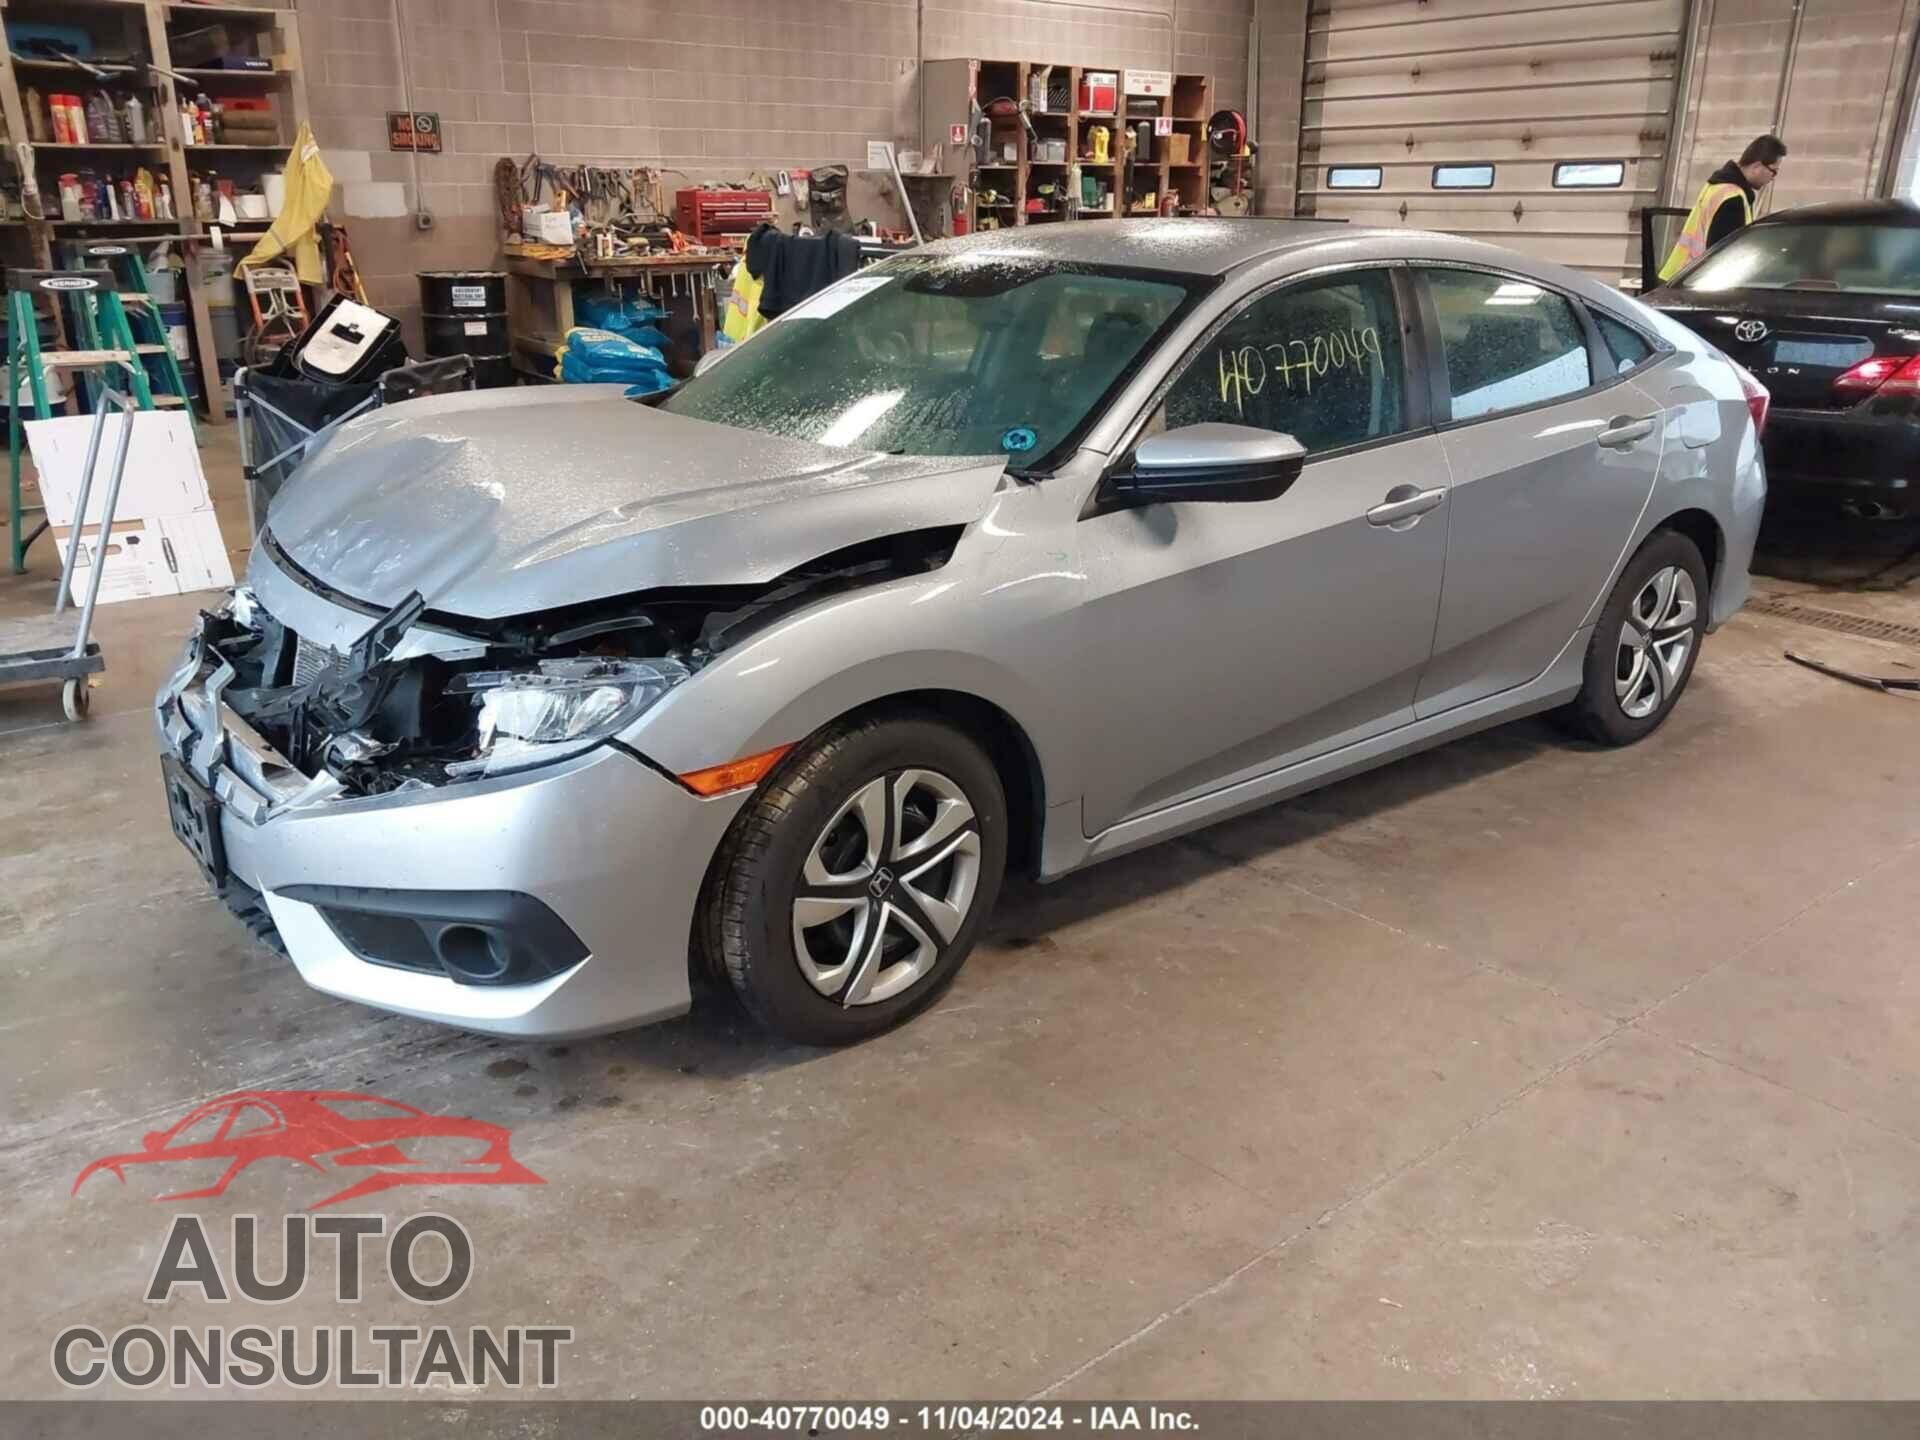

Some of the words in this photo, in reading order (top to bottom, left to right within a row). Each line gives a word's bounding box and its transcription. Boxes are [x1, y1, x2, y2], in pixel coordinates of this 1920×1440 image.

[396, 116, 412, 131] NO
[391, 131, 440, 147] SMOKING
[1217, 326, 1386, 418] 40770049
